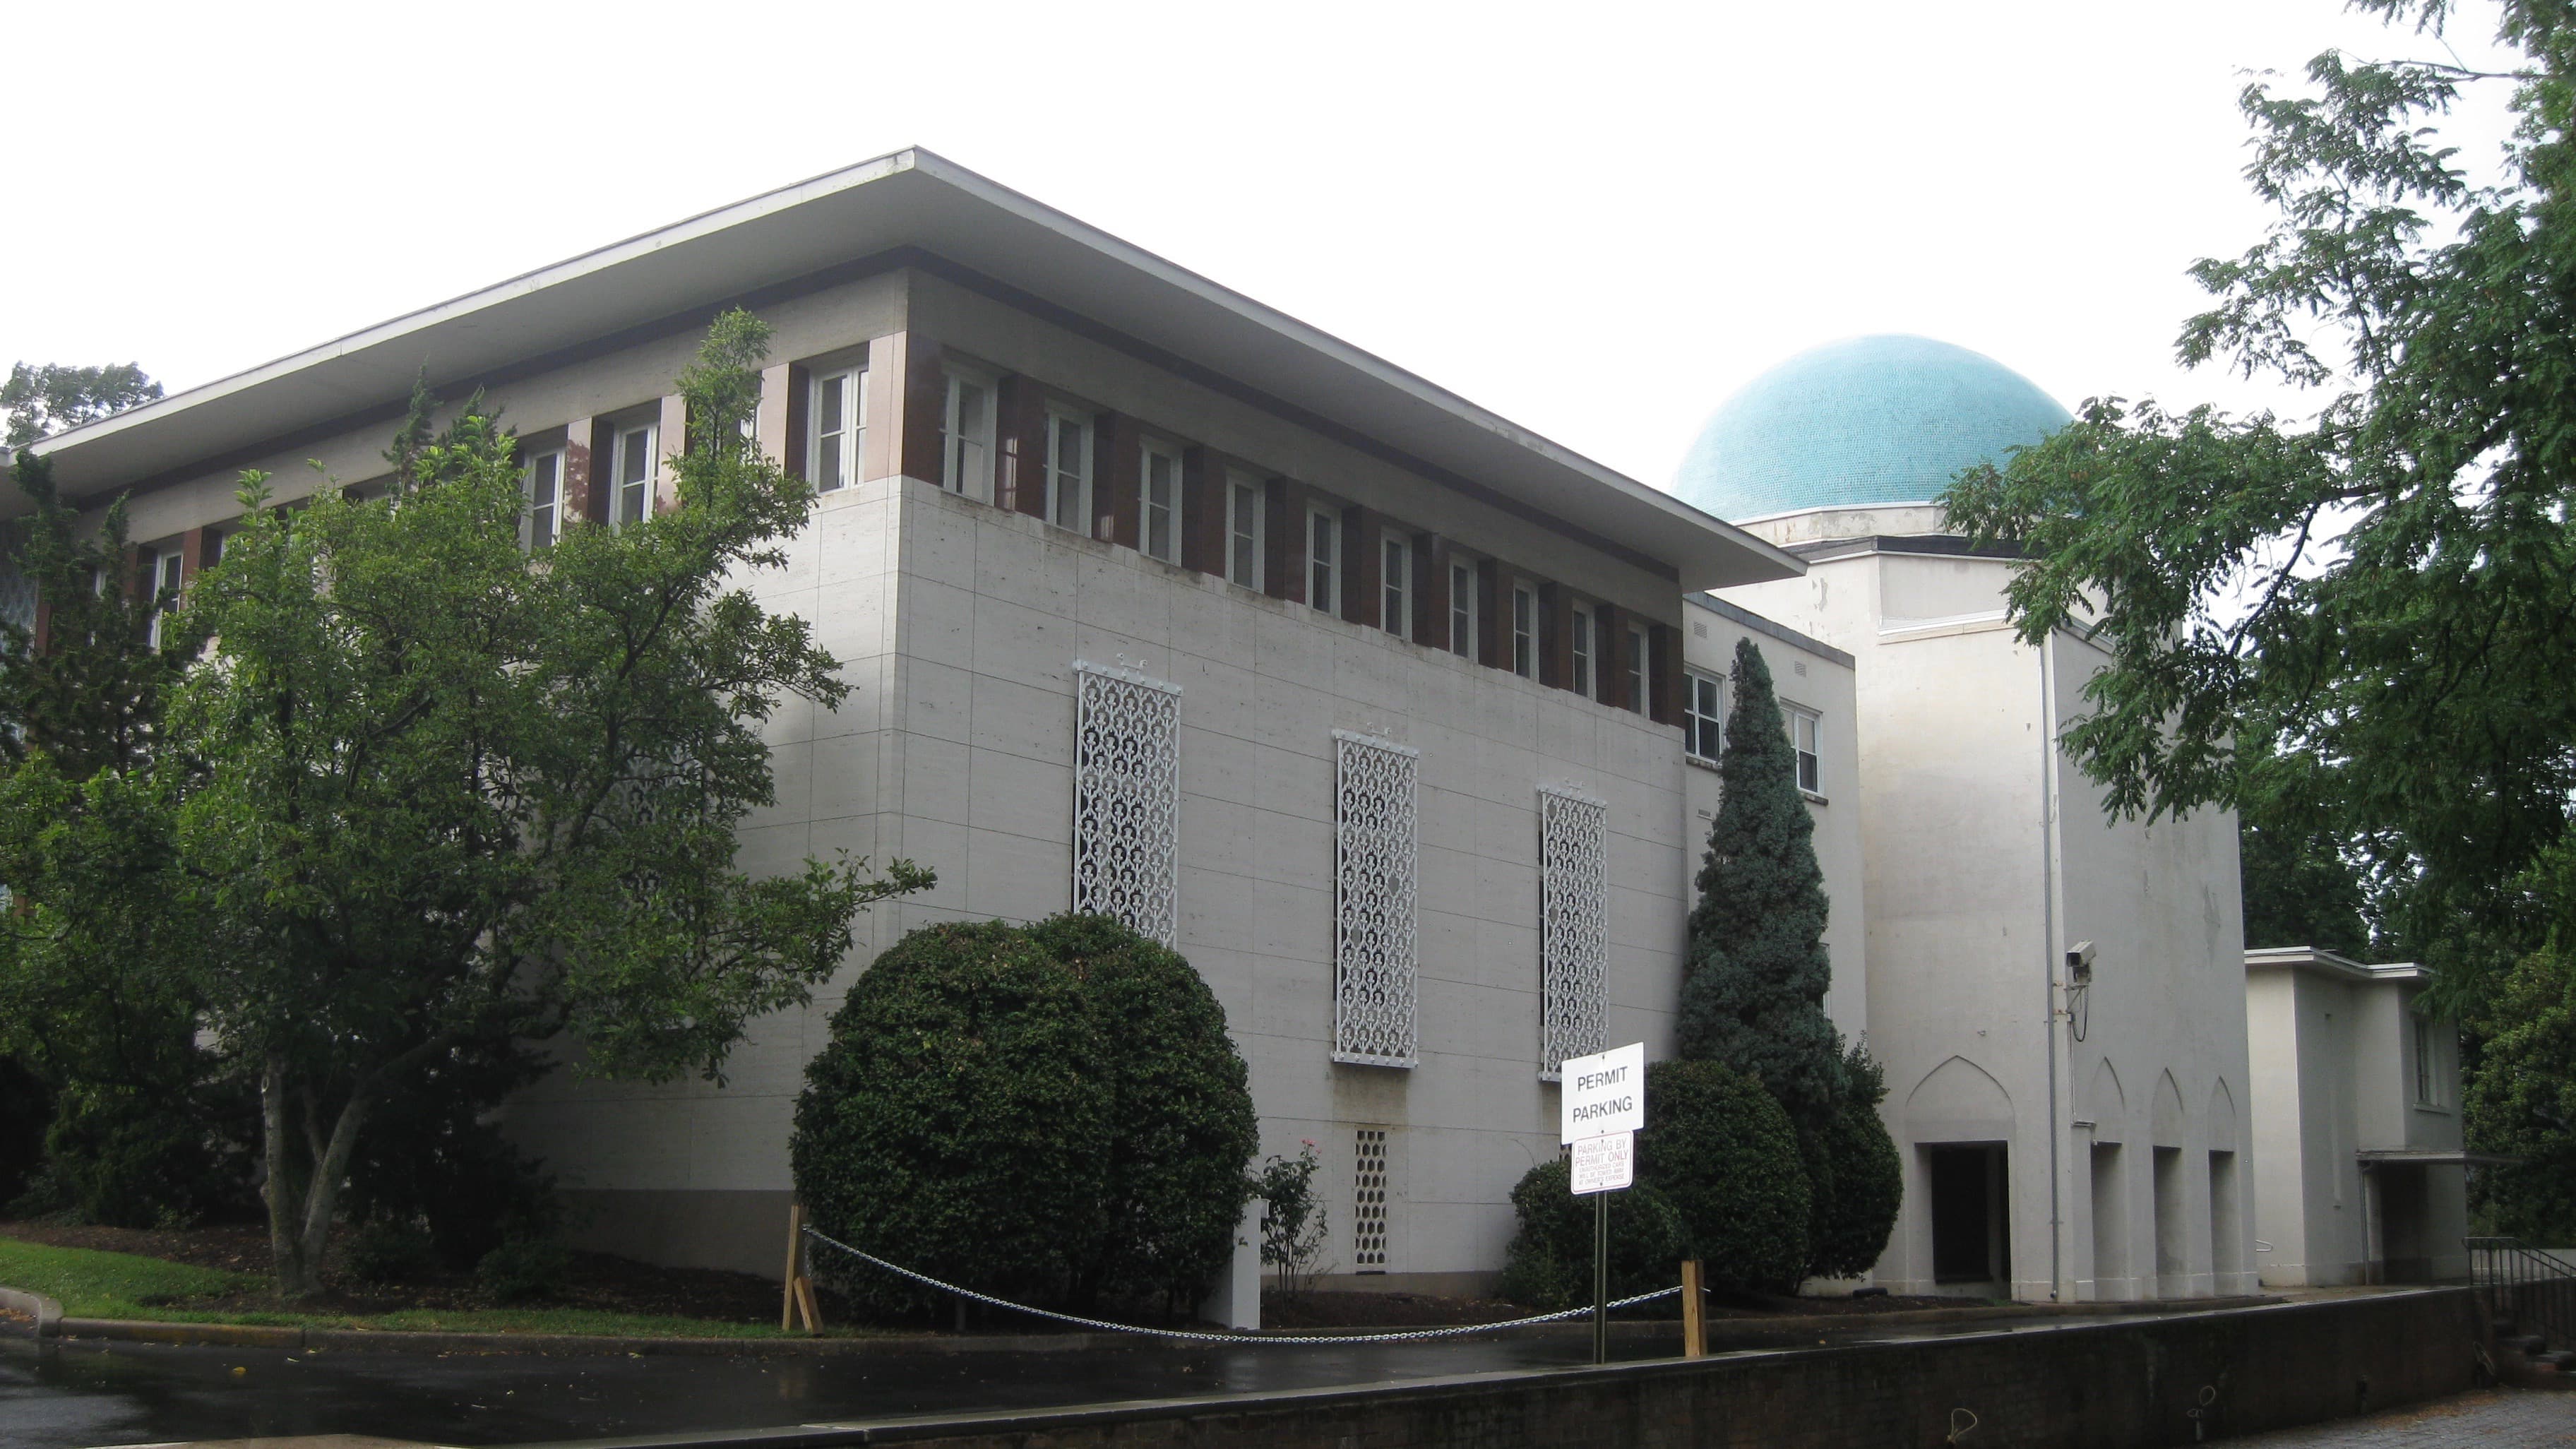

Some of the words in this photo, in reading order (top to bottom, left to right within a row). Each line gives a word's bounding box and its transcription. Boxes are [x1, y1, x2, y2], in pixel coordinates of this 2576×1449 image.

[1578, 1066, 1628, 1092] PERMIT
[1573, 1096, 1633, 1123] PARKING
[1578, 1140, 1613, 1155] PARKING
[1616, 1138, 1627, 1150] BY
[1575, 1153, 1605, 1167] PERMIT
[1608, 1149, 1629, 1162] ONLY
